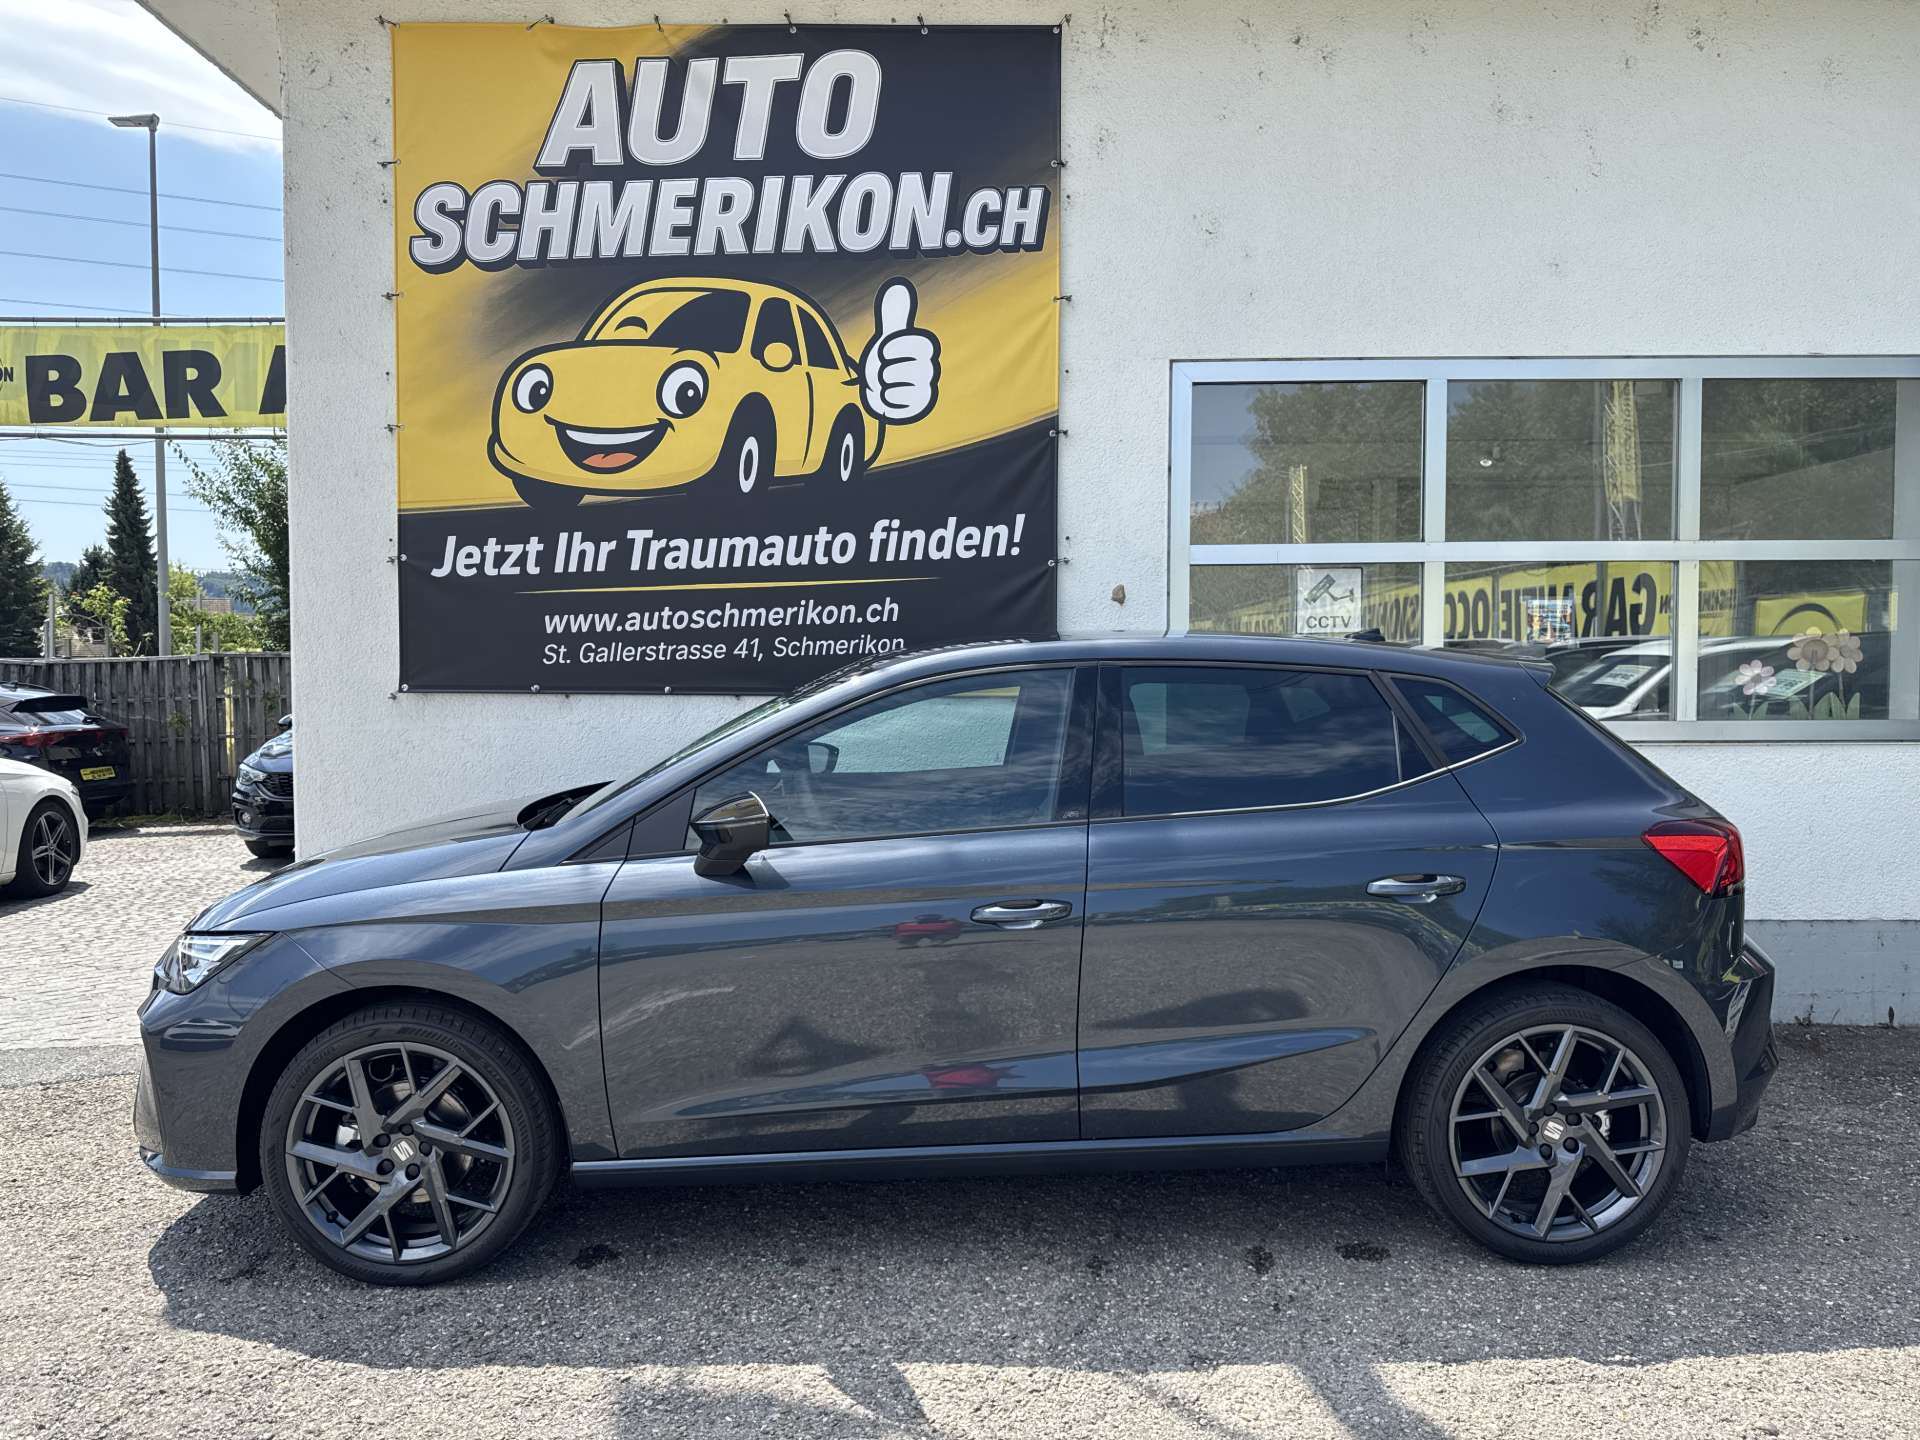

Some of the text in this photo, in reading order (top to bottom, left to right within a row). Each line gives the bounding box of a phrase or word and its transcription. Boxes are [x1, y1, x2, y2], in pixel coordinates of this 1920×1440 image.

[535, 48, 883, 171] AUTO
[410, 171, 1048, 269] SCHMERIKON.CH
[25, 349, 229, 424] BAR
[430, 512, 1026, 578] Jetzt Ihr Traumauto finden!
[544, 597, 900, 633] www.autoschmerikon.ch
[1306, 615, 1352, 630] CCTV
[542, 633, 905, 665] St. Gallerstrasse 41, Schmerikon
